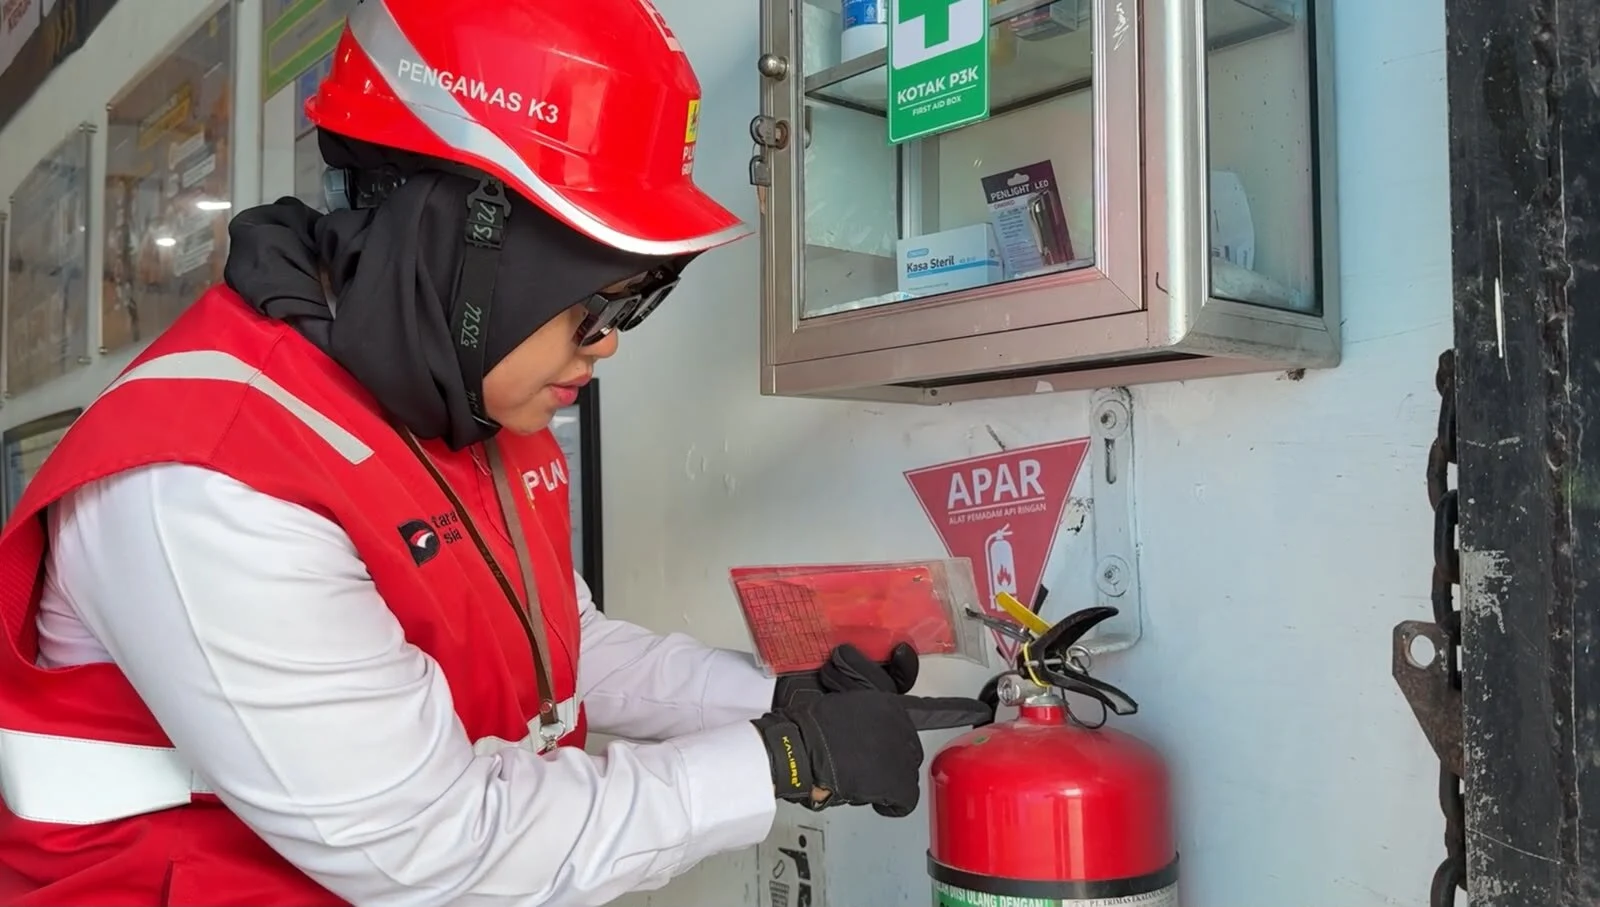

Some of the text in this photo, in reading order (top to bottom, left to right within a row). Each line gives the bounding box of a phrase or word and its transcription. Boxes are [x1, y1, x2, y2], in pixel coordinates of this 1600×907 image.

[397, 58, 560, 124] PENGAWAS K3
[897, 65, 979, 105] KOTAK P3K
[912, 95, 962, 116] FIRST AID BOX
[990, 183, 1030, 201] PENLIGHT
[906, 262, 929, 273] Kasa
[930, 255, 955, 269] Steril
[521, 458, 568, 501] PLN
[946, 458, 1045, 510] APAR
[949, 502, 1047, 525] ALAT PEMADAM API RINGAN
[782, 735, 799, 786] KALIBRE
[966, 889, 998, 907] ULANG
